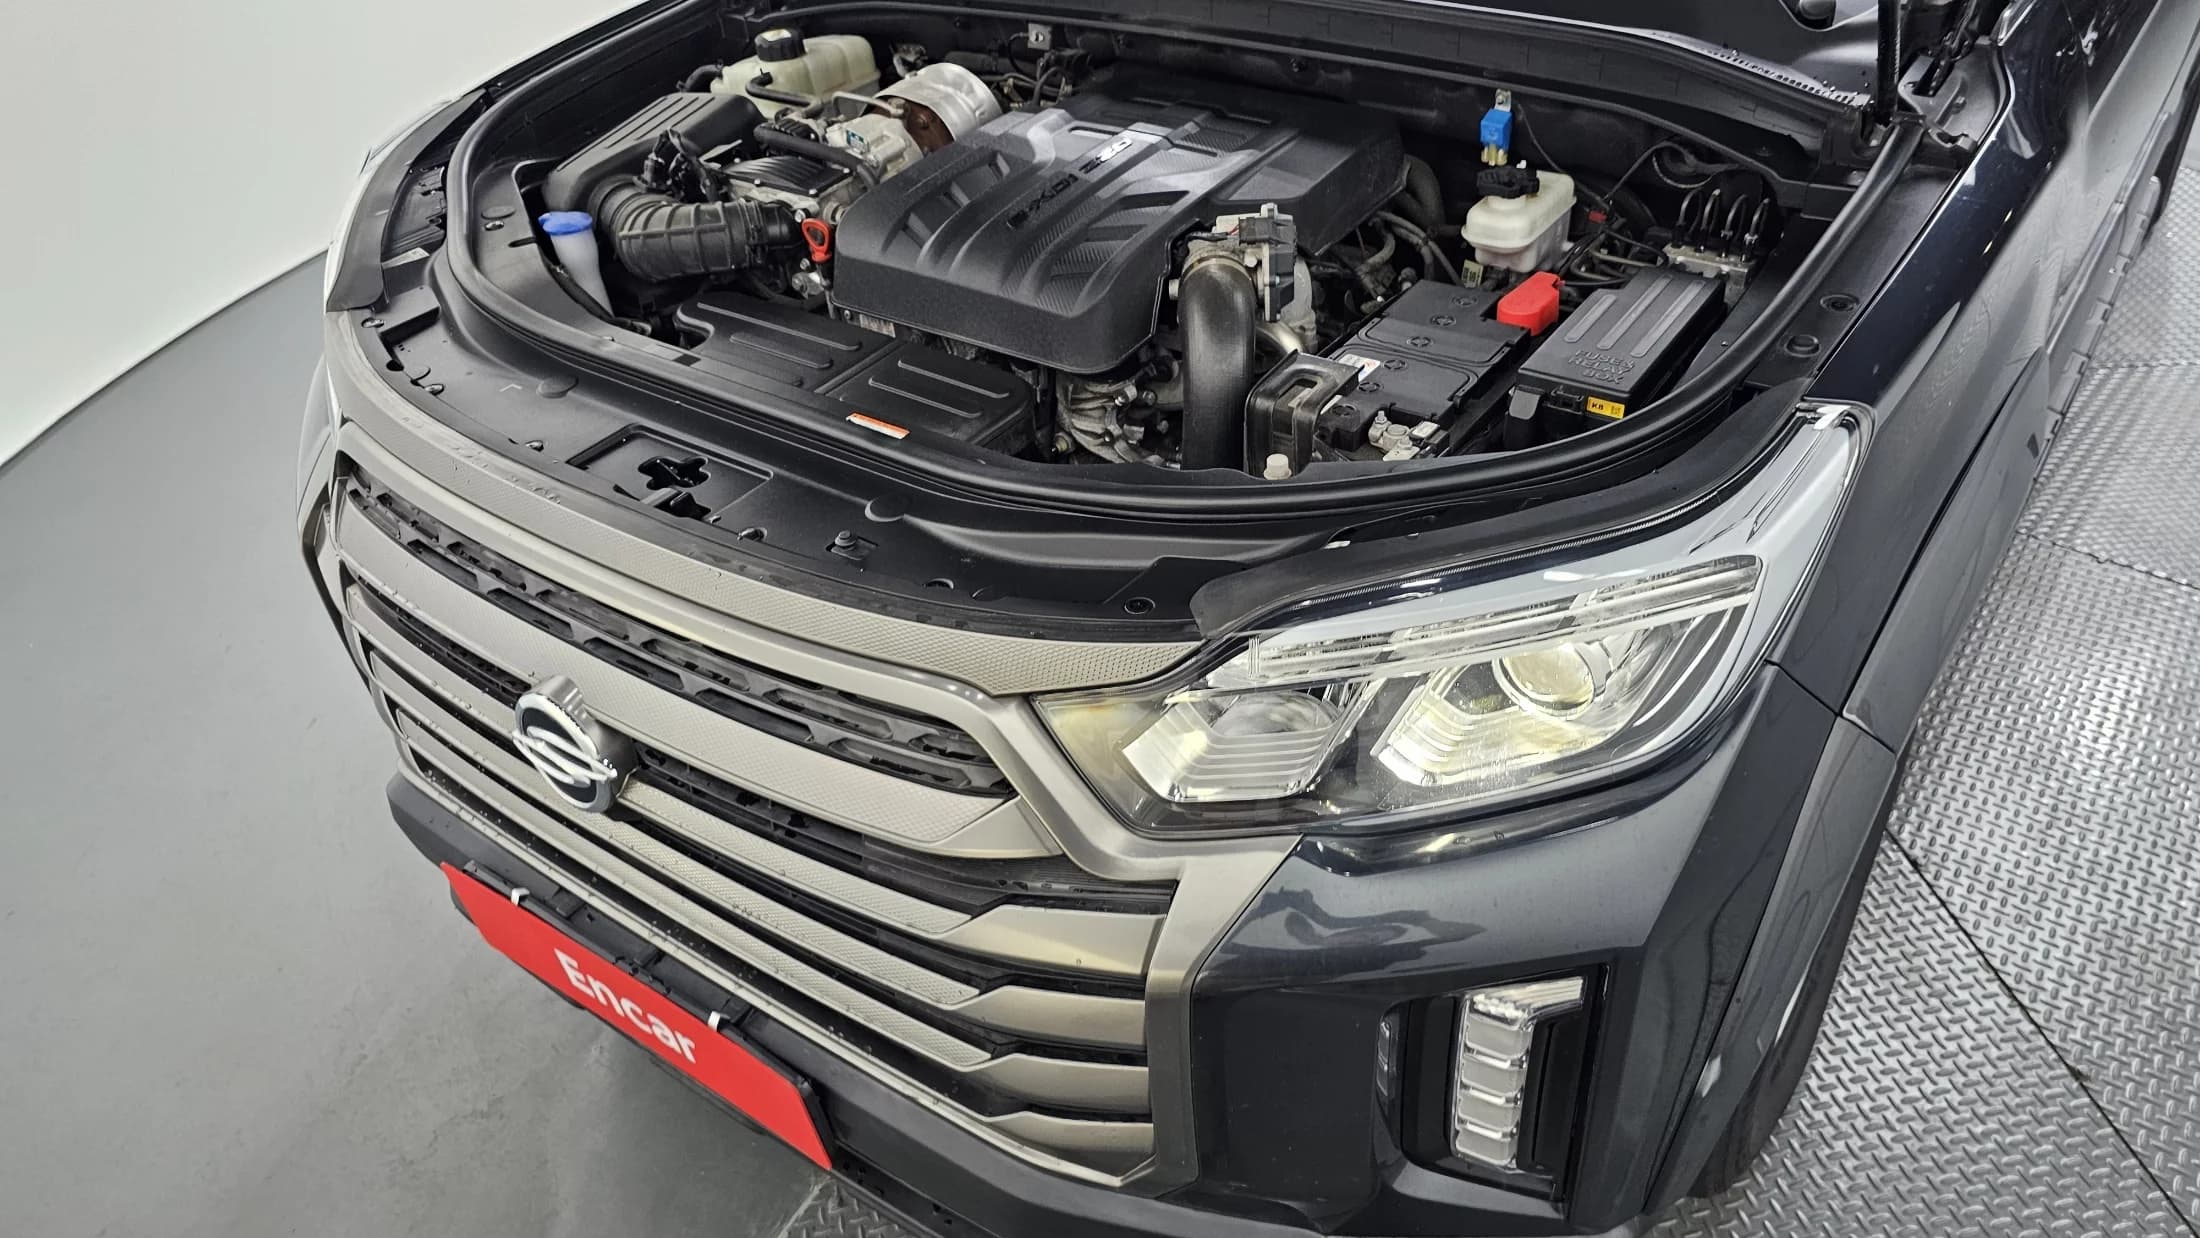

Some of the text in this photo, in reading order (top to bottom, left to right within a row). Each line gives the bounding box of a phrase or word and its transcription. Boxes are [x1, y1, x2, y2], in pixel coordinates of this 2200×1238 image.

[1567, 357, 1632, 376] RELAY
[1582, 368, 1625, 385] BOX
[553, 947, 696, 1064] Encar
